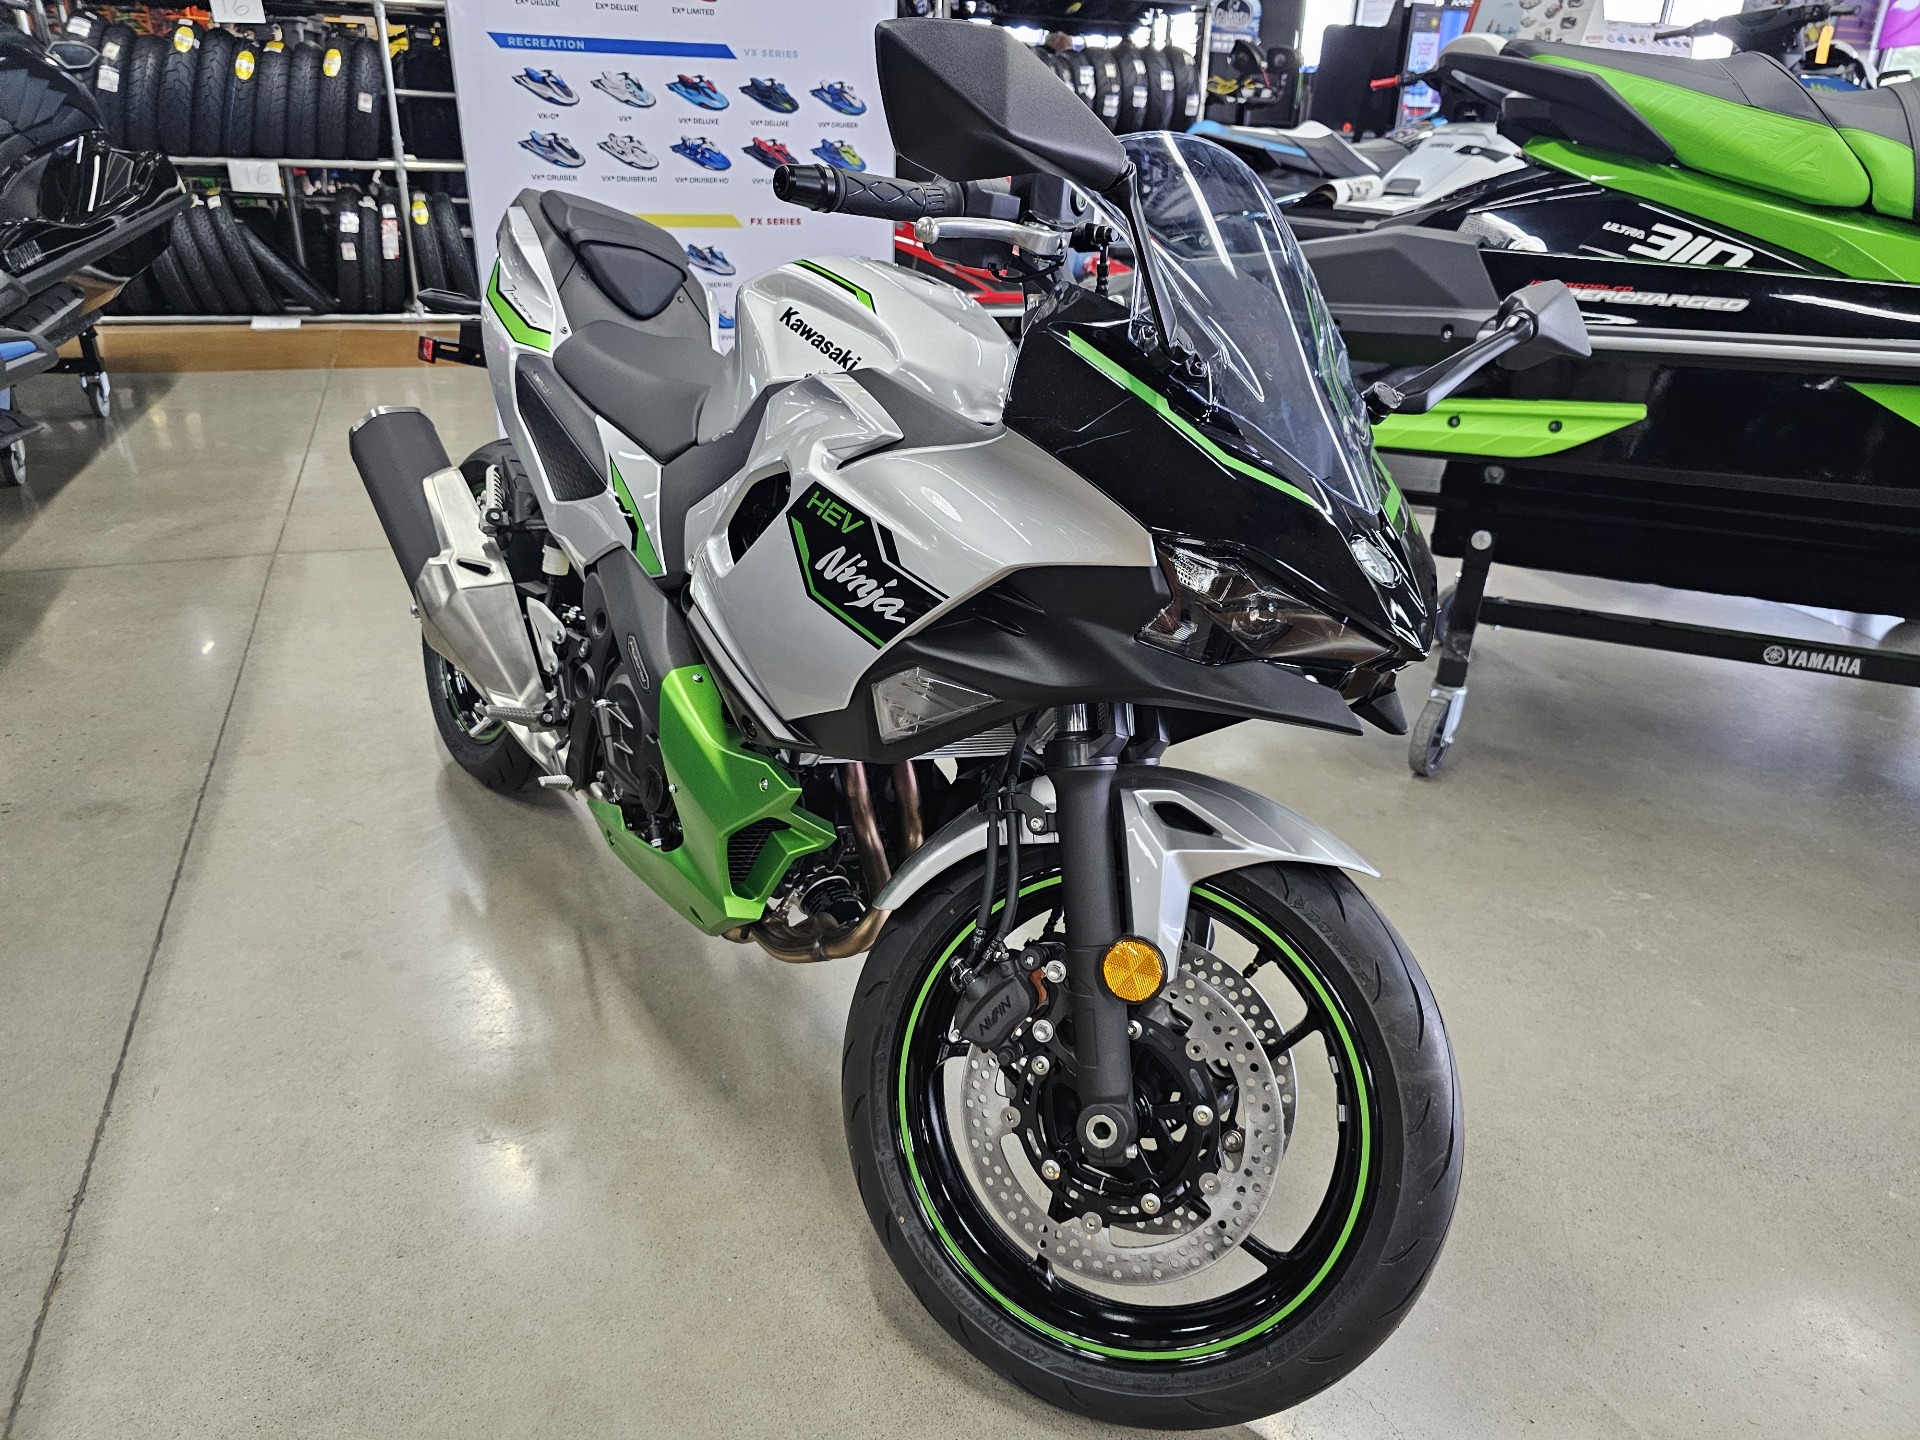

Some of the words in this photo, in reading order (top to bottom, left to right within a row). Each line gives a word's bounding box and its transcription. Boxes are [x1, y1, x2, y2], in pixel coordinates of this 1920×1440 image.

[610, 3, 639, 12] DELUXE
[686, 7, 715, 16] LIMITED
[507, 36, 585, 50] RECREATION
[743, 48, 758, 57] VX
[762, 49, 799, 59] SERIES
[693, 118, 720, 126] DELUXE
[764, 120, 790, 128] DELUXE
[246, 163, 270, 185] 16
[750, 217, 763, 226] FX
[767, 218, 802, 226] SERIES
[1602, 220, 1646, 240] ULTRA
[1628, 223, 1755, 268] 310
[779, 306, 862, 372] Kawasaki
[806, 490, 865, 534] HEV
[814, 545, 906, 624] Ninja
[1786, 648, 1861, 675] YAMAHA
